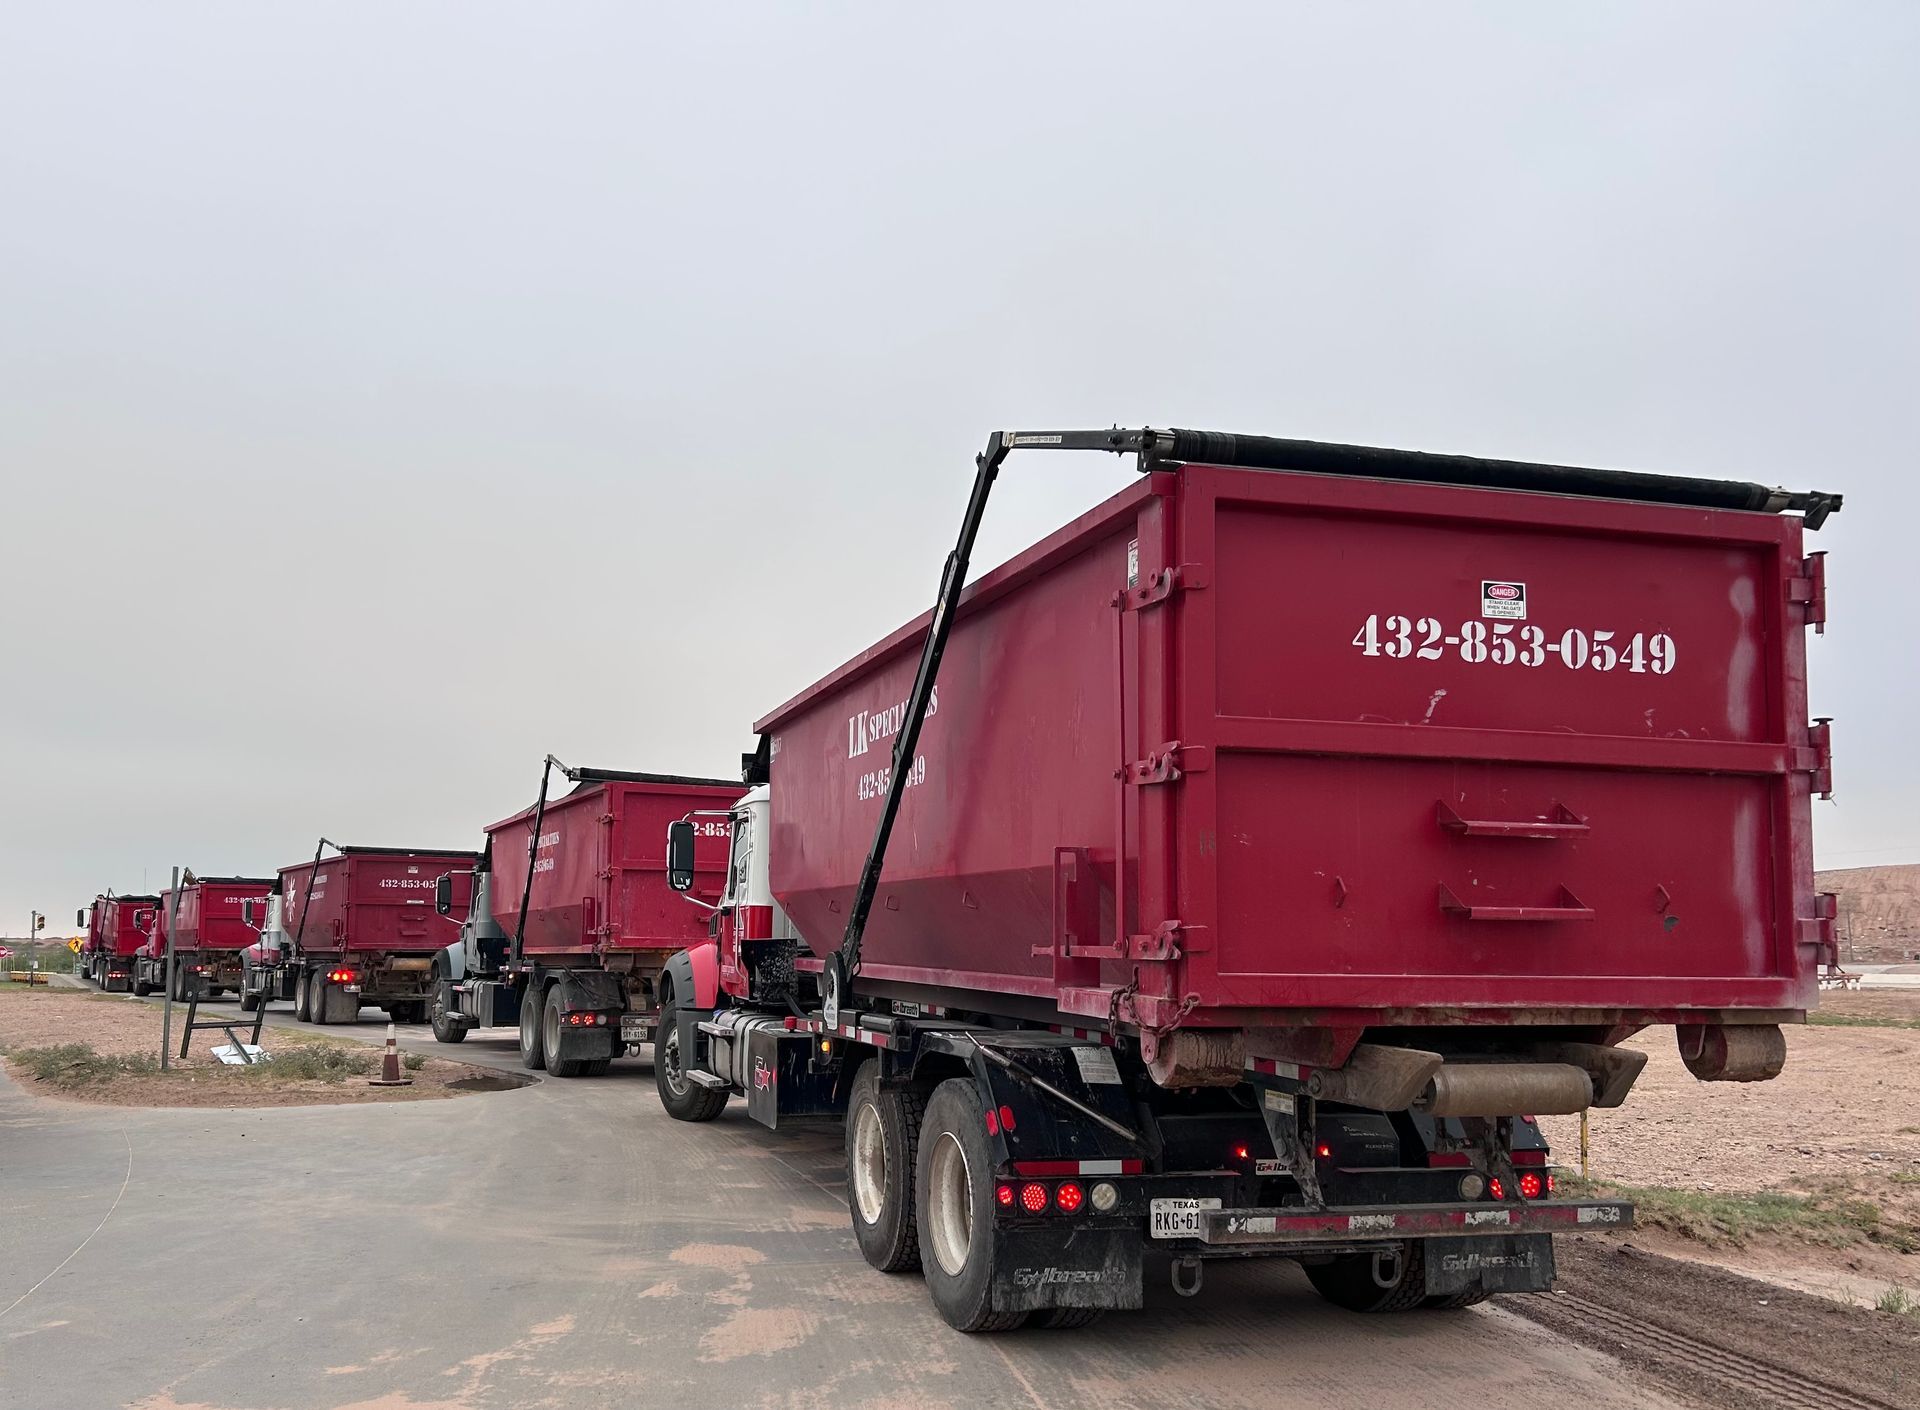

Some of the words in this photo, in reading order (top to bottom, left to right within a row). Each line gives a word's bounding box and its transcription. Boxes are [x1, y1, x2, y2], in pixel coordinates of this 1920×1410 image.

[1491, 587, 1515, 597] DANGER
[1352, 614, 1676, 675] 432-853-0549
[848, 710, 868, 759] LK
[379, 879, 435, 889] 432-853-05
[1173, 1201, 1199, 1209] TEXAS
